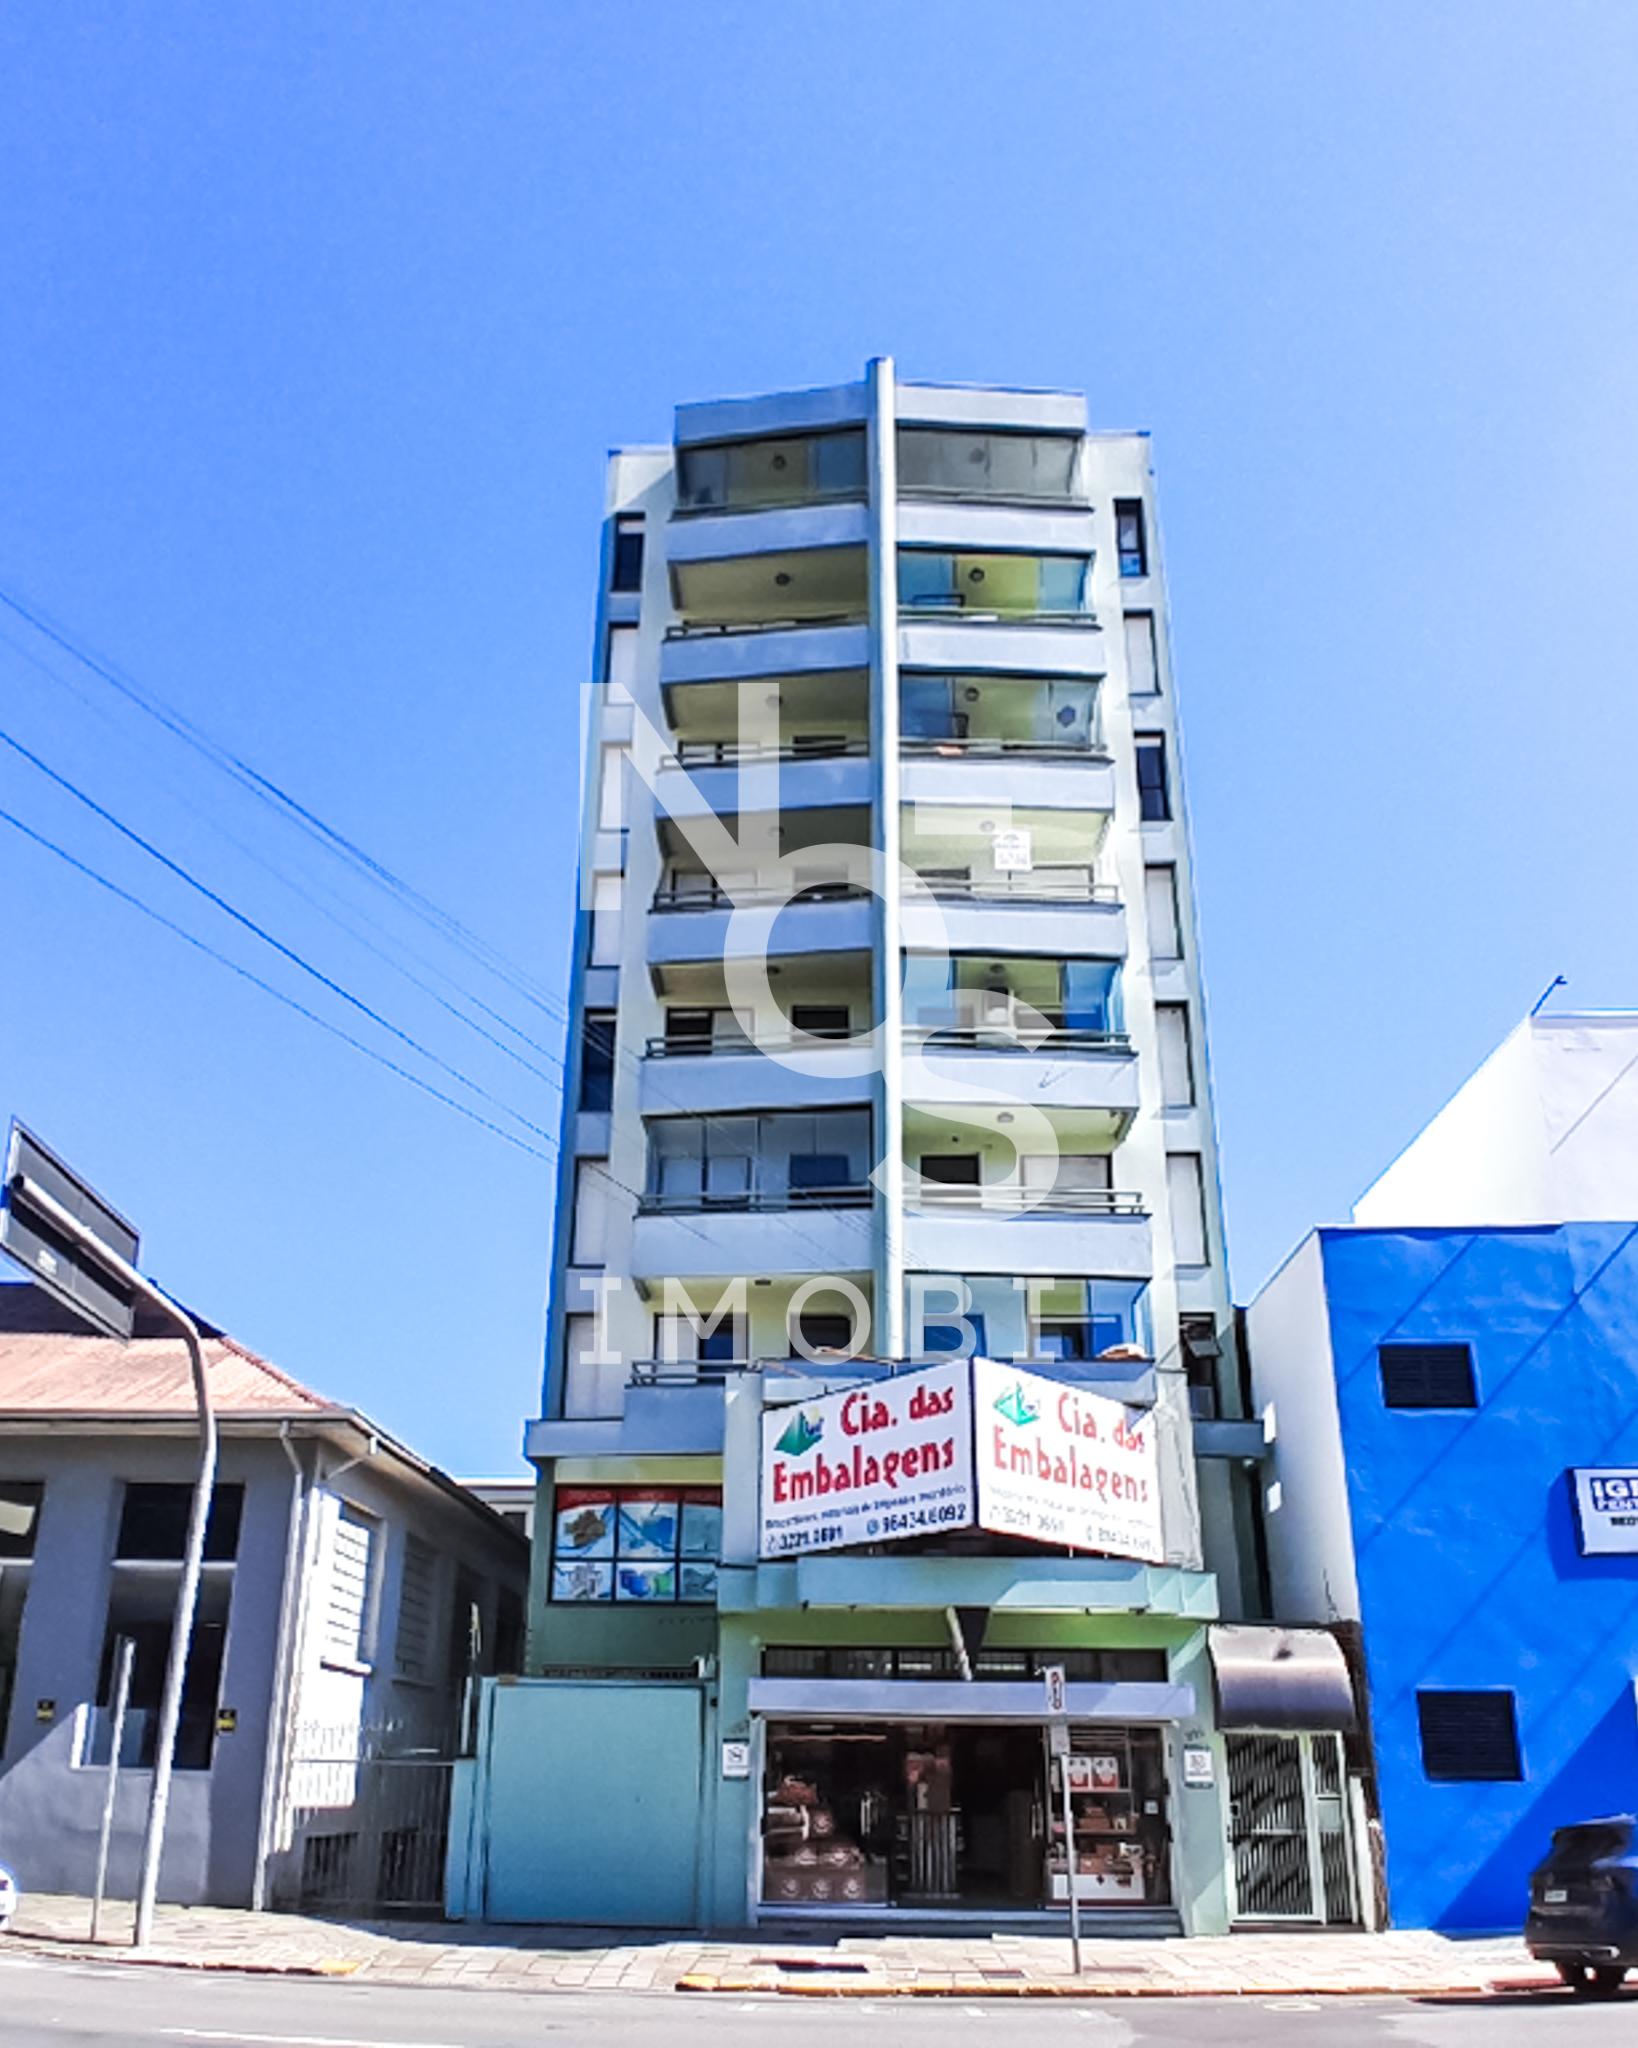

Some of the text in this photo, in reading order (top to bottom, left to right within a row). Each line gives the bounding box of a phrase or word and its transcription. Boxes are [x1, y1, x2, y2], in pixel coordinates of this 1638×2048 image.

[840, 1384, 954, 1436] Cia. das
[1058, 1392, 1146, 1453] Cia. das
[773, 1438, 954, 1504] Embalagens
[993, 1424, 1149, 1504] Embalagens
